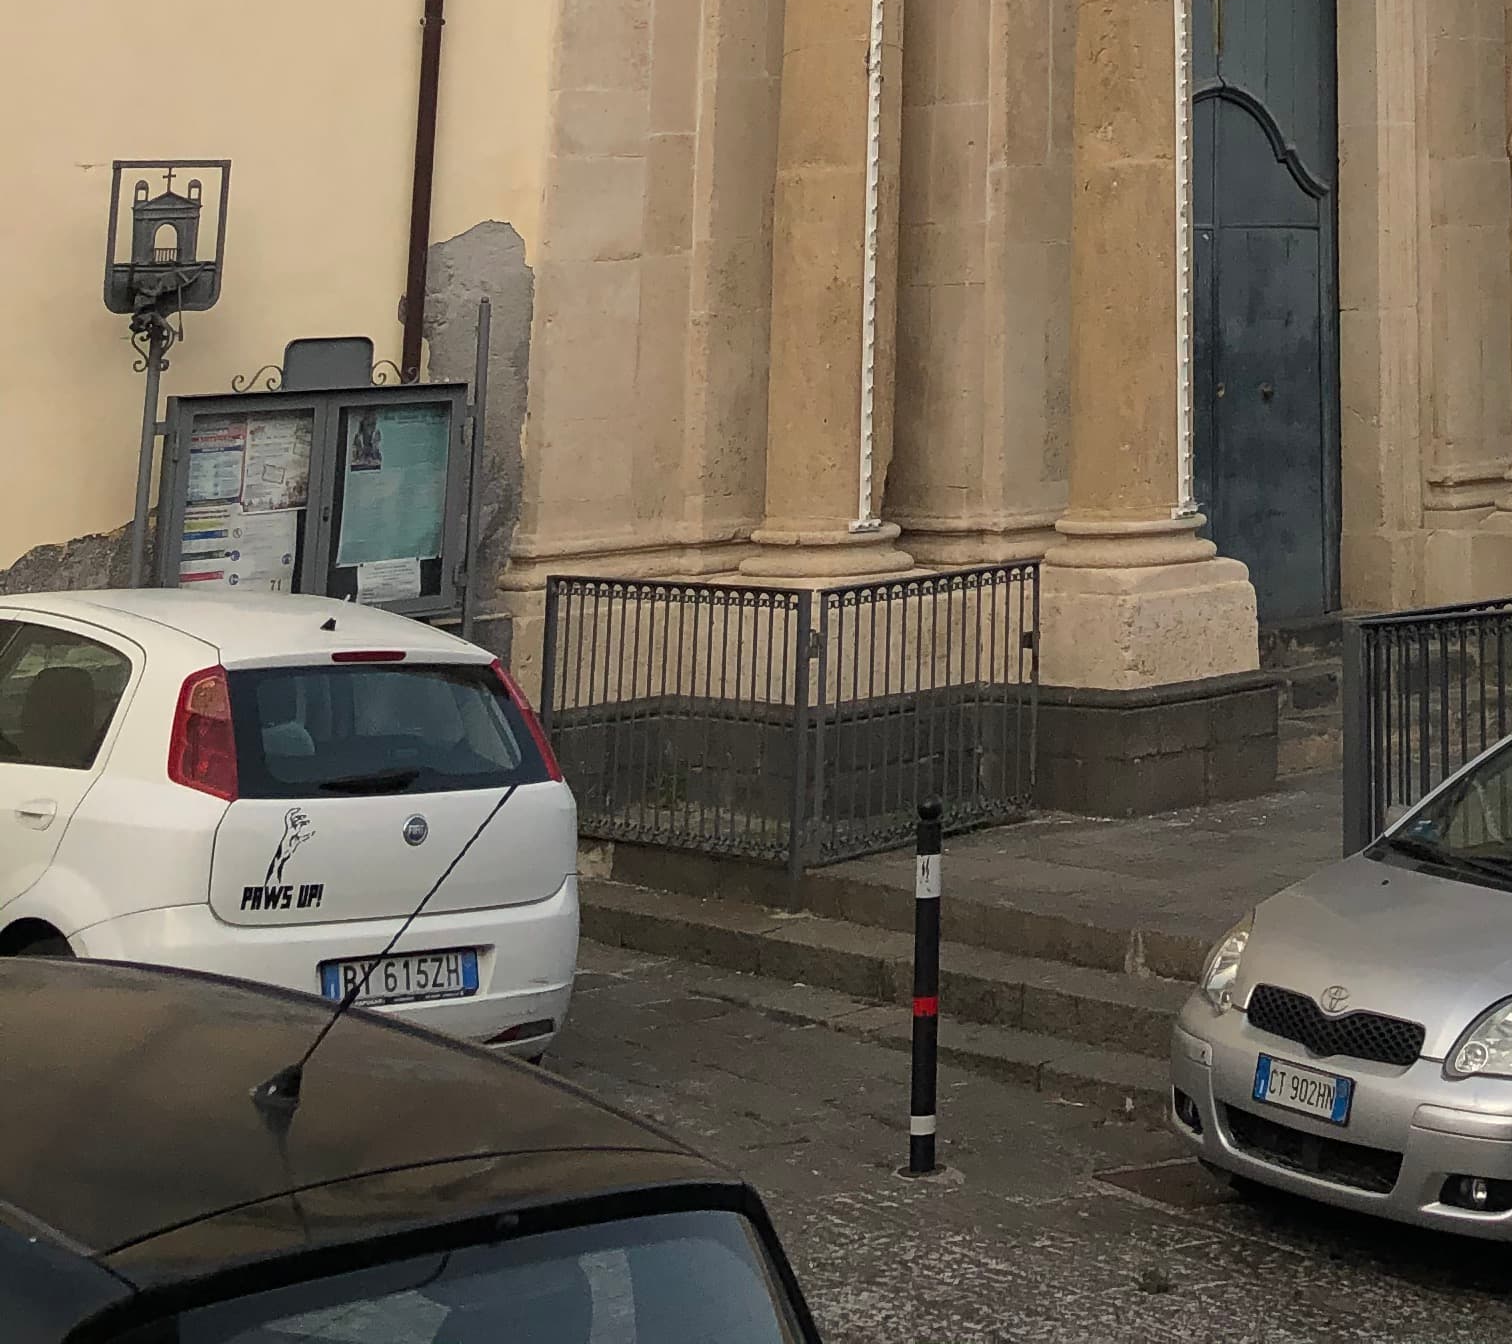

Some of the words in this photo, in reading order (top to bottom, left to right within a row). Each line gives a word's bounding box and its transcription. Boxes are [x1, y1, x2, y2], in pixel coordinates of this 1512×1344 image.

[240, 885, 293, 910] PAWS
[296, 883, 325, 908] UP!
[384, 952, 460, 993] 615ZH
[1269, 1068, 1286, 1097] CT
[1290, 1075, 1335, 1111] 902HN
